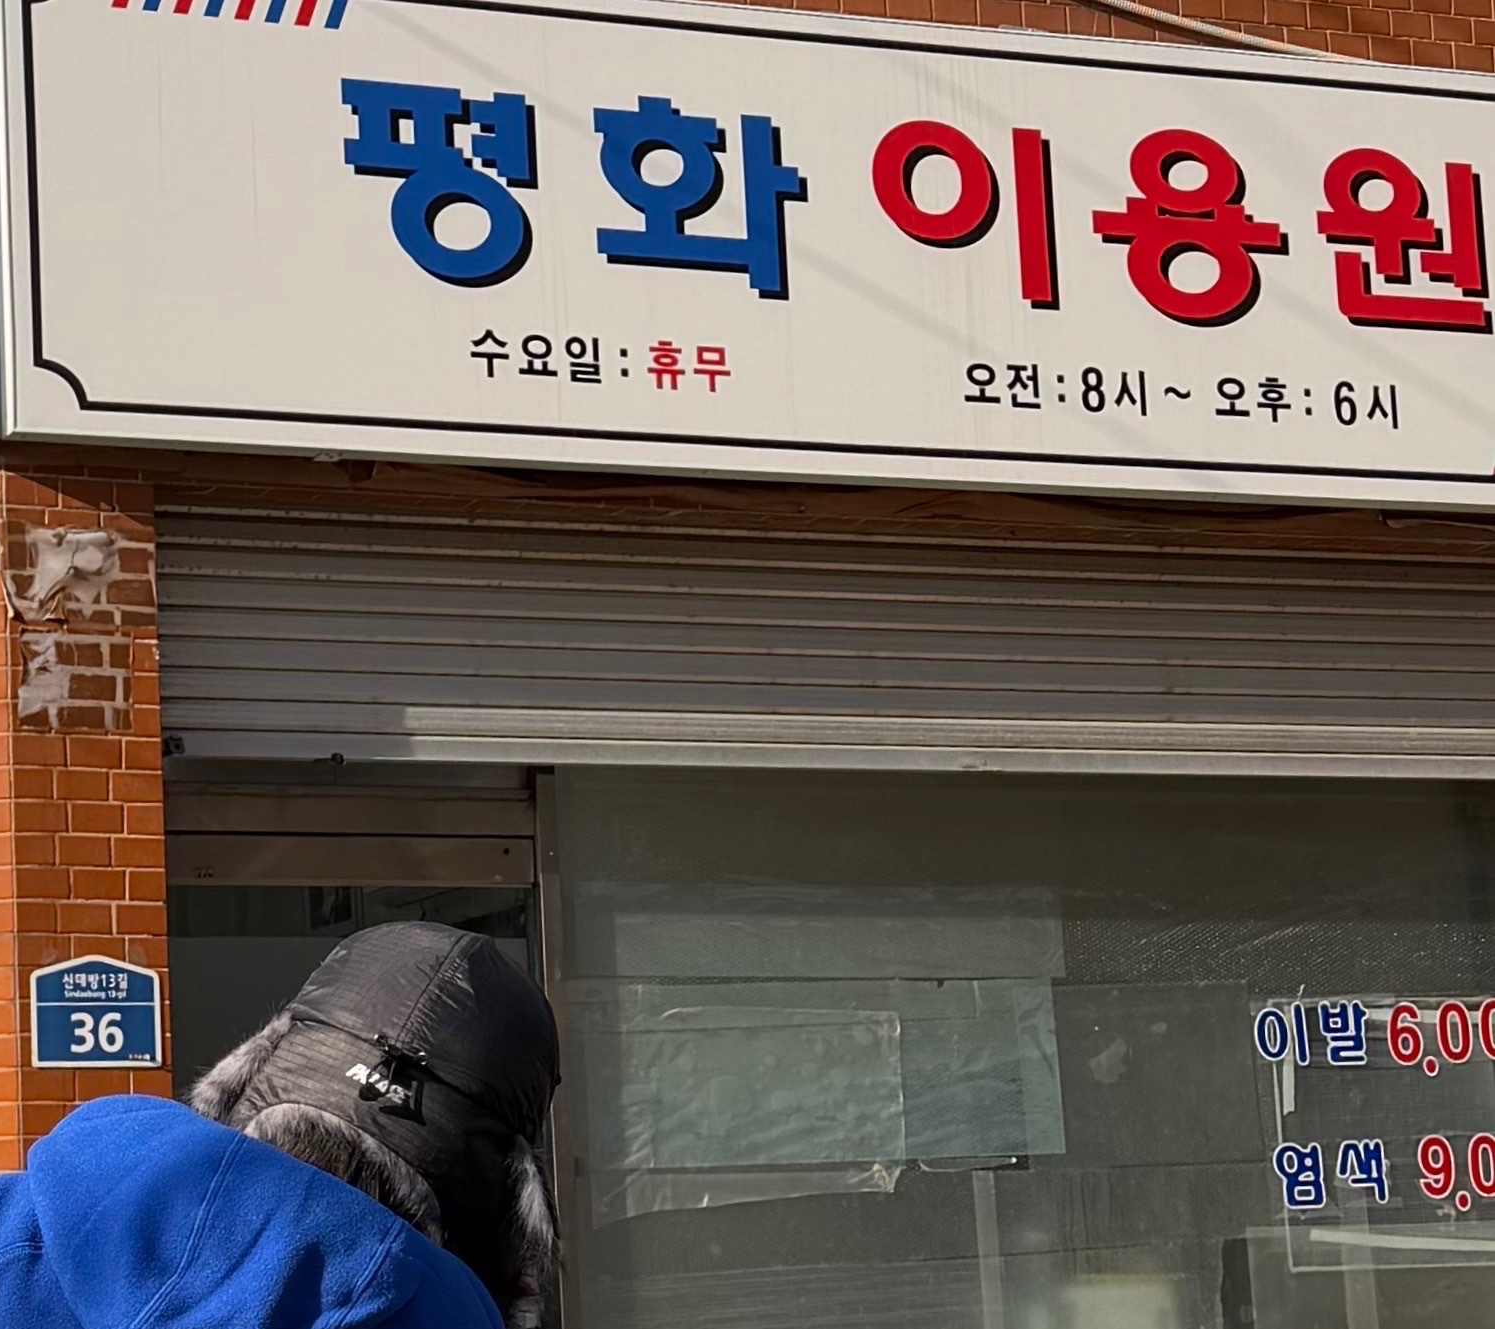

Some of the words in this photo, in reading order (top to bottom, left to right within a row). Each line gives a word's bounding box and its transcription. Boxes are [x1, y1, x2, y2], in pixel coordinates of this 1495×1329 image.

[340, 77, 809, 301] 평화
[871, 119, 1493, 335] 이용원
[647, 340, 732, 393] 휴무
[70, 1012, 124, 1053] 36
[1254, 1000, 1369, 1066] 이발
[1272, 1138, 1390, 1209] 염색
